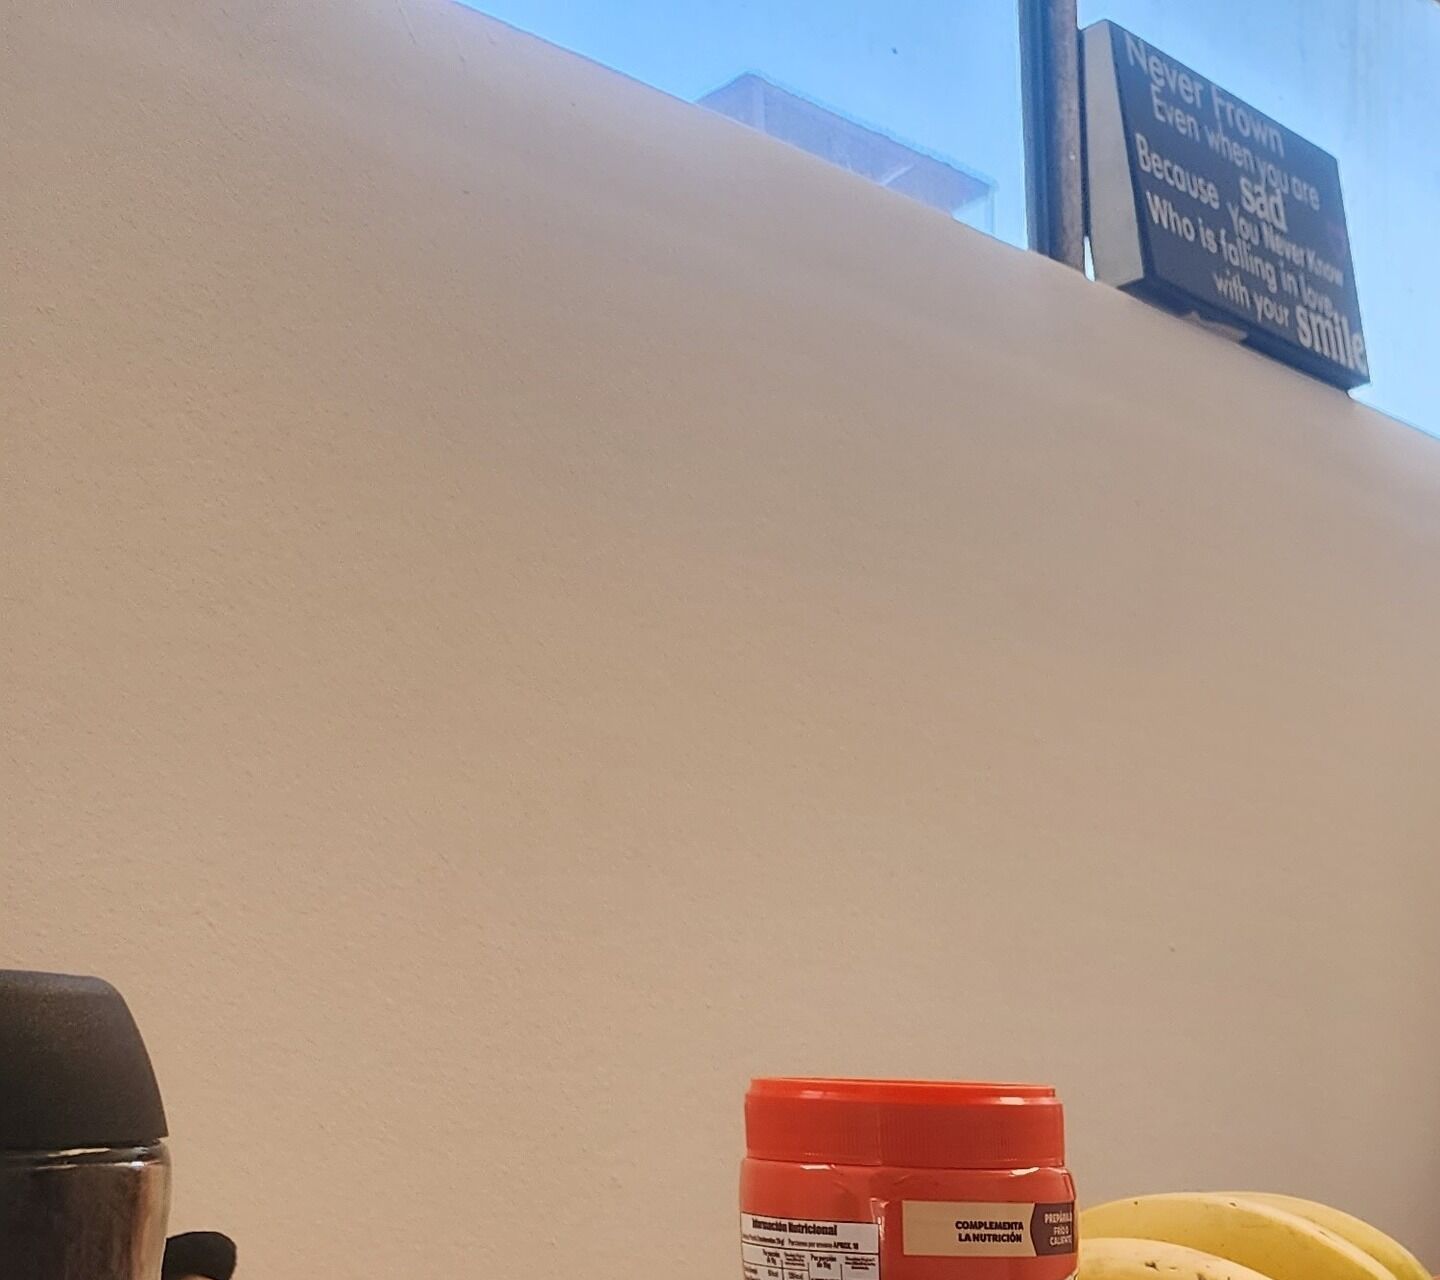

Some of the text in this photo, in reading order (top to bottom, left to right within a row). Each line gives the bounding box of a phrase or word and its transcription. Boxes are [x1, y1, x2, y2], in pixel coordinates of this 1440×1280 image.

[1124, 31, 1285, 158] Never Frown
[1150, 83, 1320, 211] Even when you are
[1135, 132, 1220, 209] Because
[1226, 201, 1259, 245] You
[1146, 190, 1195, 242] Who
[1198, 217, 1217, 254] is
[1220, 228, 1277, 294] falling
[1279, 260, 1298, 298] in
[1213, 268, 1251, 310] with
[1253, 290, 1289, 328] your
[955, 1220, 1024, 1230] COMPLEMENTA
[958, 1232, 1022, 1243] LA NUTRICIÓN
